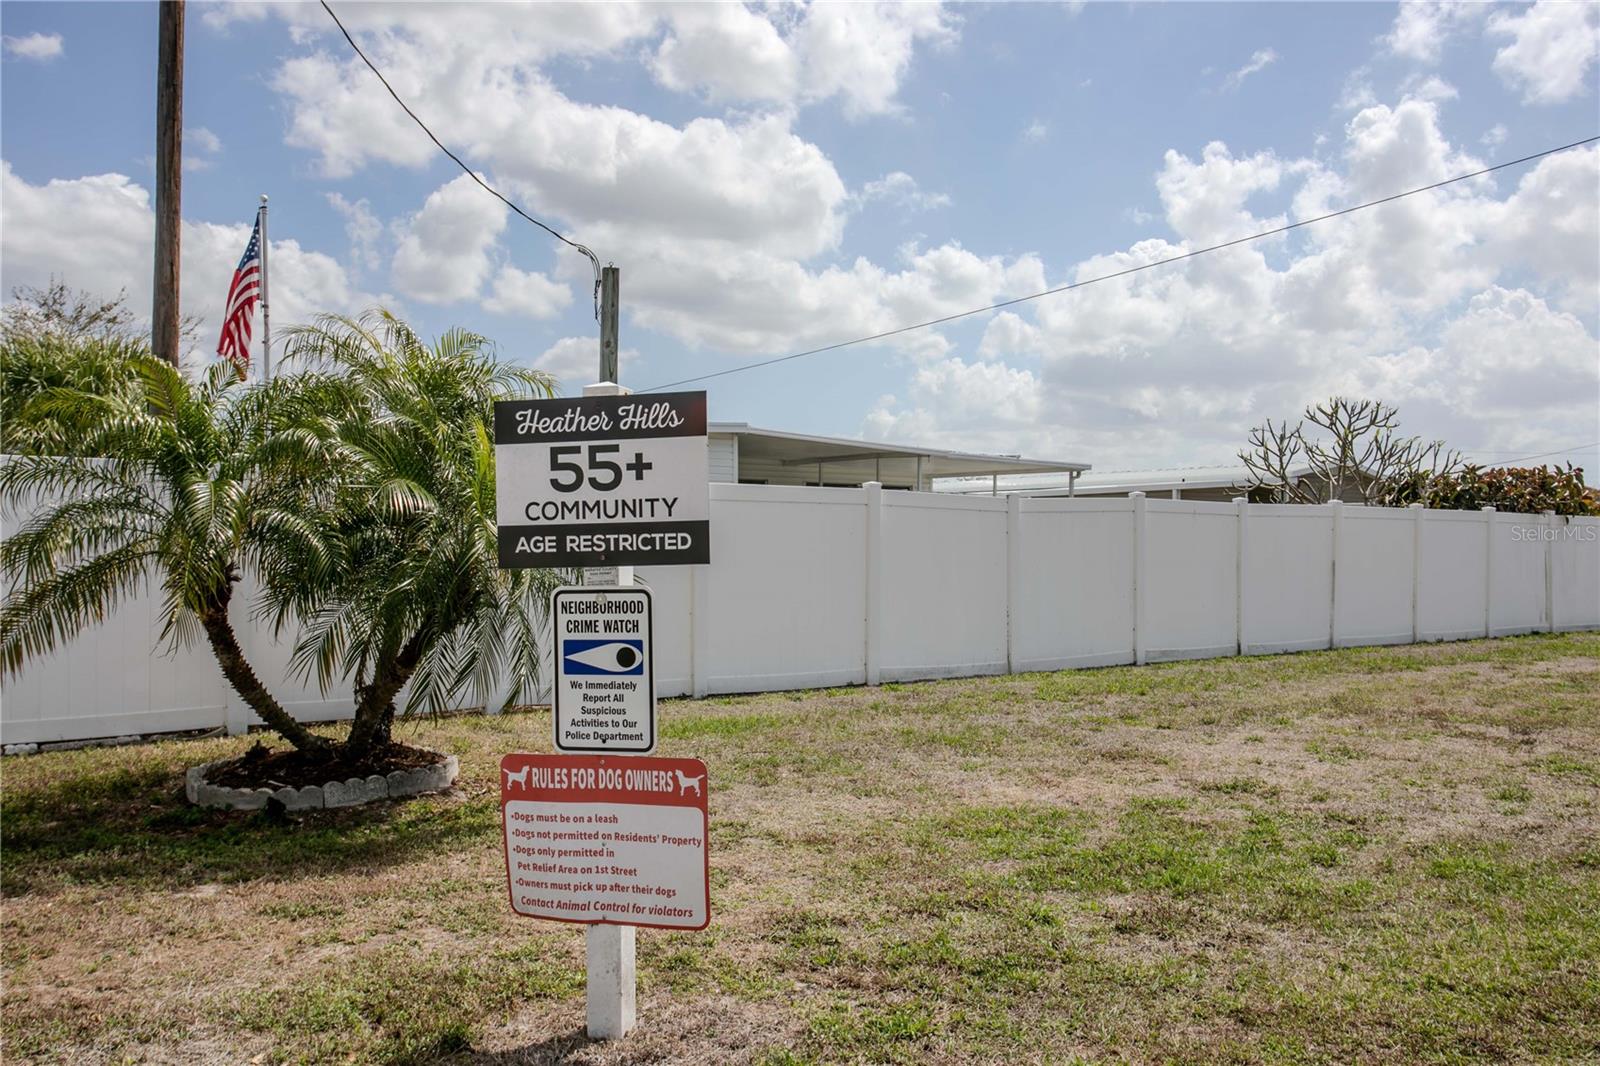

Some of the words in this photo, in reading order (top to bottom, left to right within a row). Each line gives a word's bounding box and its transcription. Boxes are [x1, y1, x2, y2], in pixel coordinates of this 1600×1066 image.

[515, 407, 614, 435] Heather
[618, 402, 684, 429] Hills
[550, 444, 653, 493] 55+
[525, 497, 678, 521] COMMUNITY
[515, 536, 556, 553] AGE
[567, 533, 692, 552] RESTRICTED
[561, 600, 644, 614] NEIGHBORHOOD
[566, 620, 599, 633] CRIME
[603, 620, 639, 633] WATCH
[570, 681, 583, 689] We
[585, 681, 637, 692] Immediately
[583, 694, 611, 704] Report
[613, 694, 624, 702] All
[581, 706, 626, 717] Suspicious
[571, 719, 609, 728] Activities
[611, 719, 620, 727] to
[622, 719, 637, 728] Our
[566, 731, 590, 740] Police
[593, 731, 643, 743] Department
[532, 767, 568, 789] RULES
[572, 768, 595, 789] FOR
[599, 768, 621, 790] DOG
[625, 770, 674, 792] OWNERS
[537, 814, 558, 823] must
[560, 813, 570, 823] be
[573, 815, 585, 823] on
[595, 814, 618, 824] leash
[537, 830, 551, 839] not
[553, 831, 599, 842] permitted
[602, 832, 612, 840] on
[615, 833, 659, 843] Residents'
[662, 835, 702, 848] Property
[537, 847, 555, 858] only
[558, 847, 604, 859] permitted
[606, 848, 615, 857] in
[517, 862, 530, 871] Pet
[533, 862, 556, 872] Relief
[558, 865, 578, 873] Area
[580, 865, 592, 874] on
[595, 865, 609, 875] 1st
[611, 866, 637, 876] Street
[550, 880, 572, 891] must
[574, 881, 593, 893] pick
[595, 883, 607, 893] up
[609, 882, 630, 893] after
[632, 884, 653, 895] their
[655, 886, 676, 898] dogs
[521, 896, 554, 909] Contact
[556, 899, 591, 911] Animal
[594, 901, 630, 913] Control
[632, 903, 647, 914] for
[649, 904, 693, 918] violators
